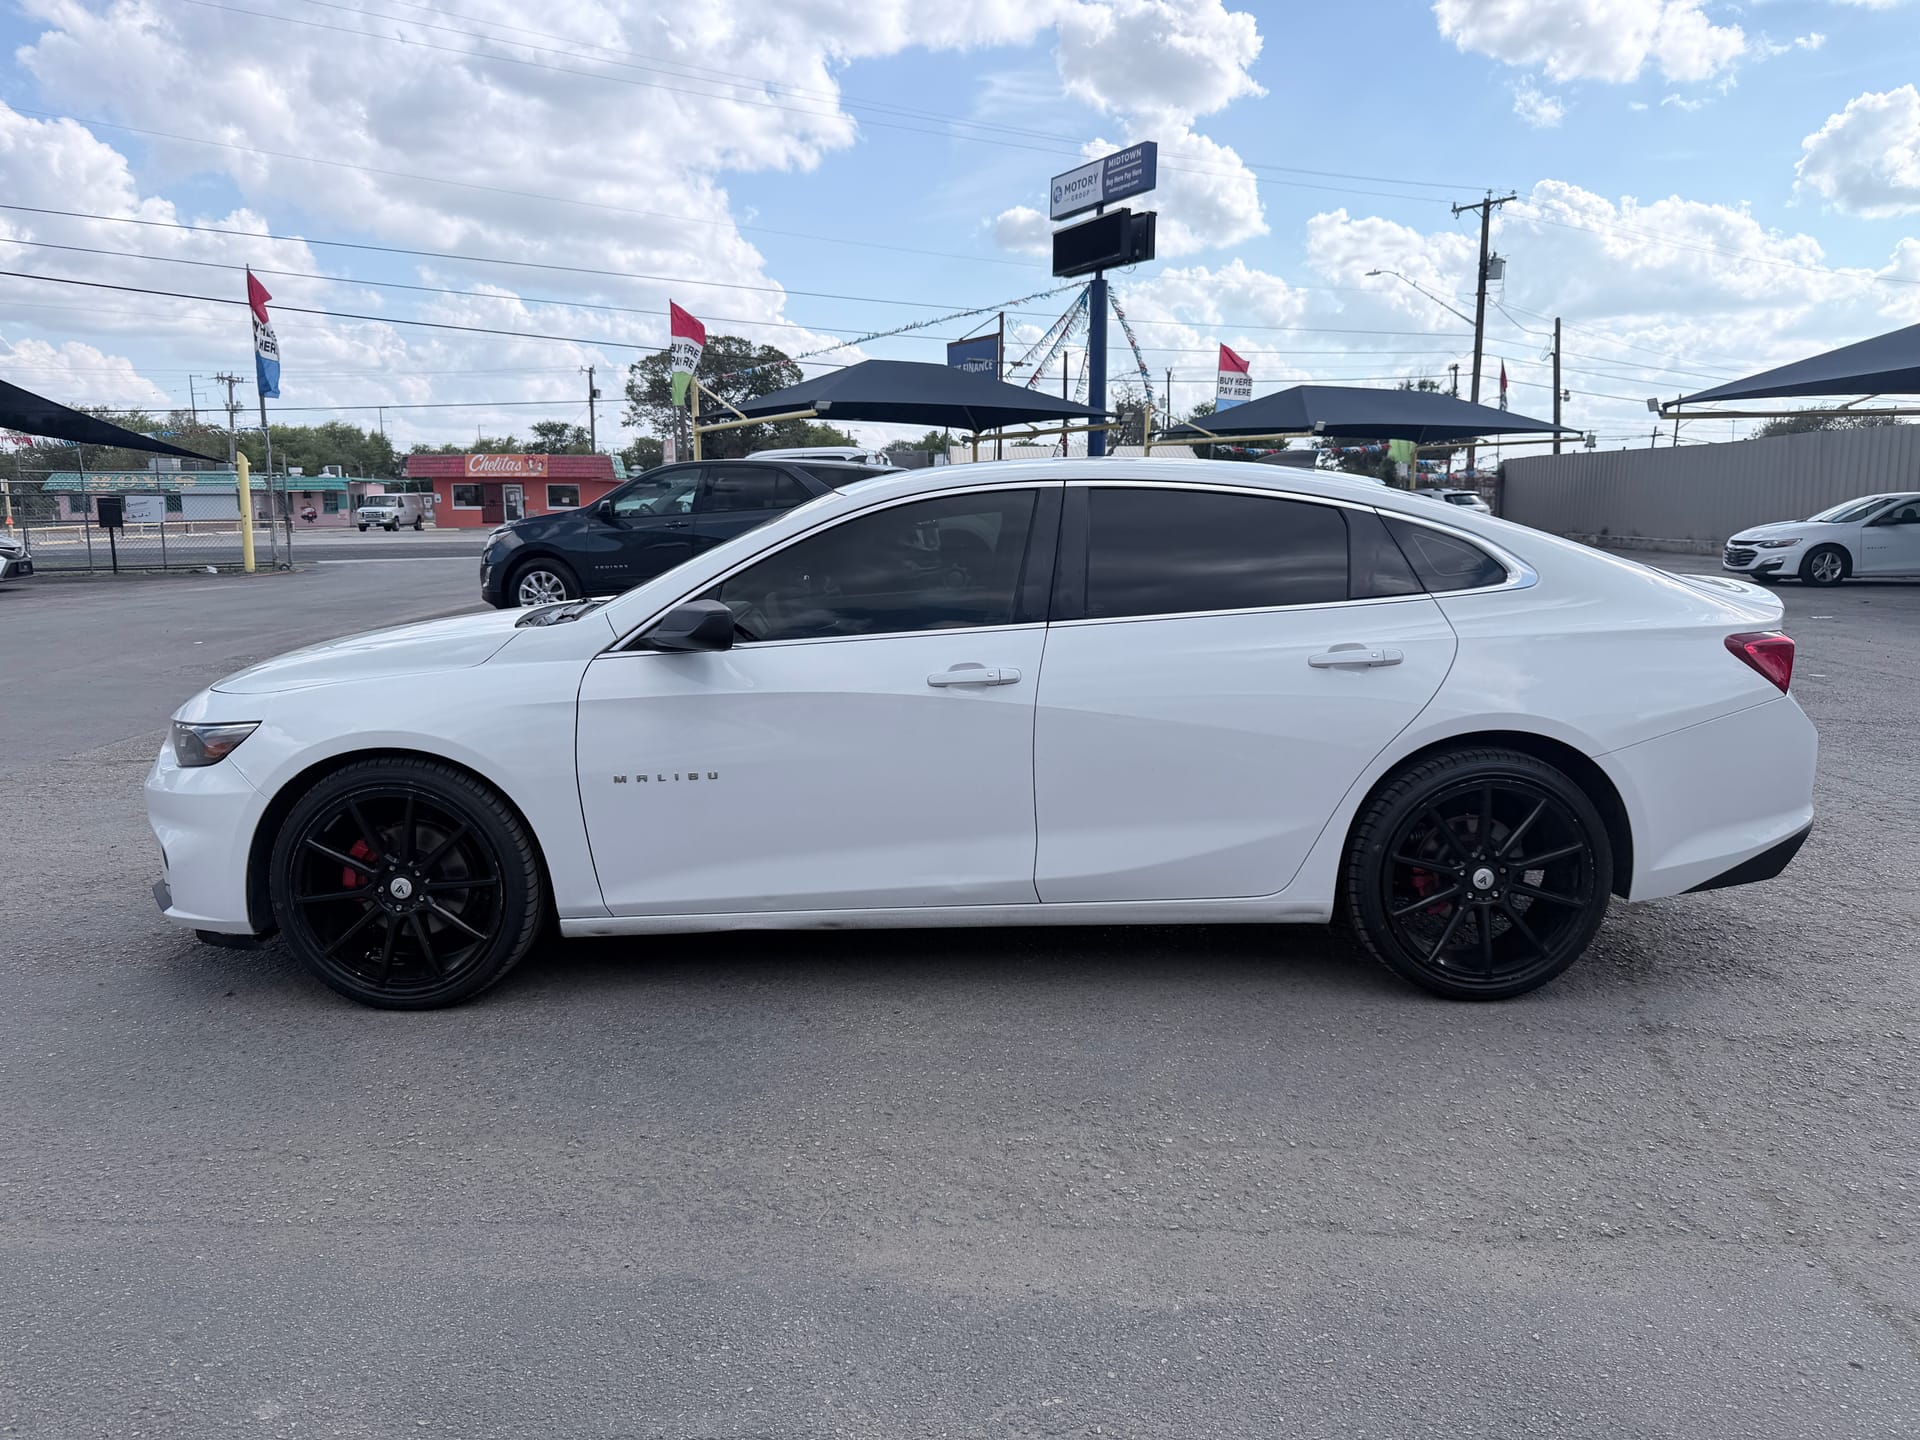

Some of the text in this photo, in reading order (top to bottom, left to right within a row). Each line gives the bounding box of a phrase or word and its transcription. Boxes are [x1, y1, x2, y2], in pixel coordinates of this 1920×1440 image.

[1107, 148, 1142, 168] MIDTOWN
[1064, 172, 1099, 195] MOTORY
[259, 339, 278, 355] HER
[962, 360, 993, 373] FINANCE
[1219, 376, 1253, 387] BUY HERE
[1219, 387, 1252, 396] PAY HERE
[469, 454, 522, 472] Chelitas
[613, 771, 719, 784] MALIBU
